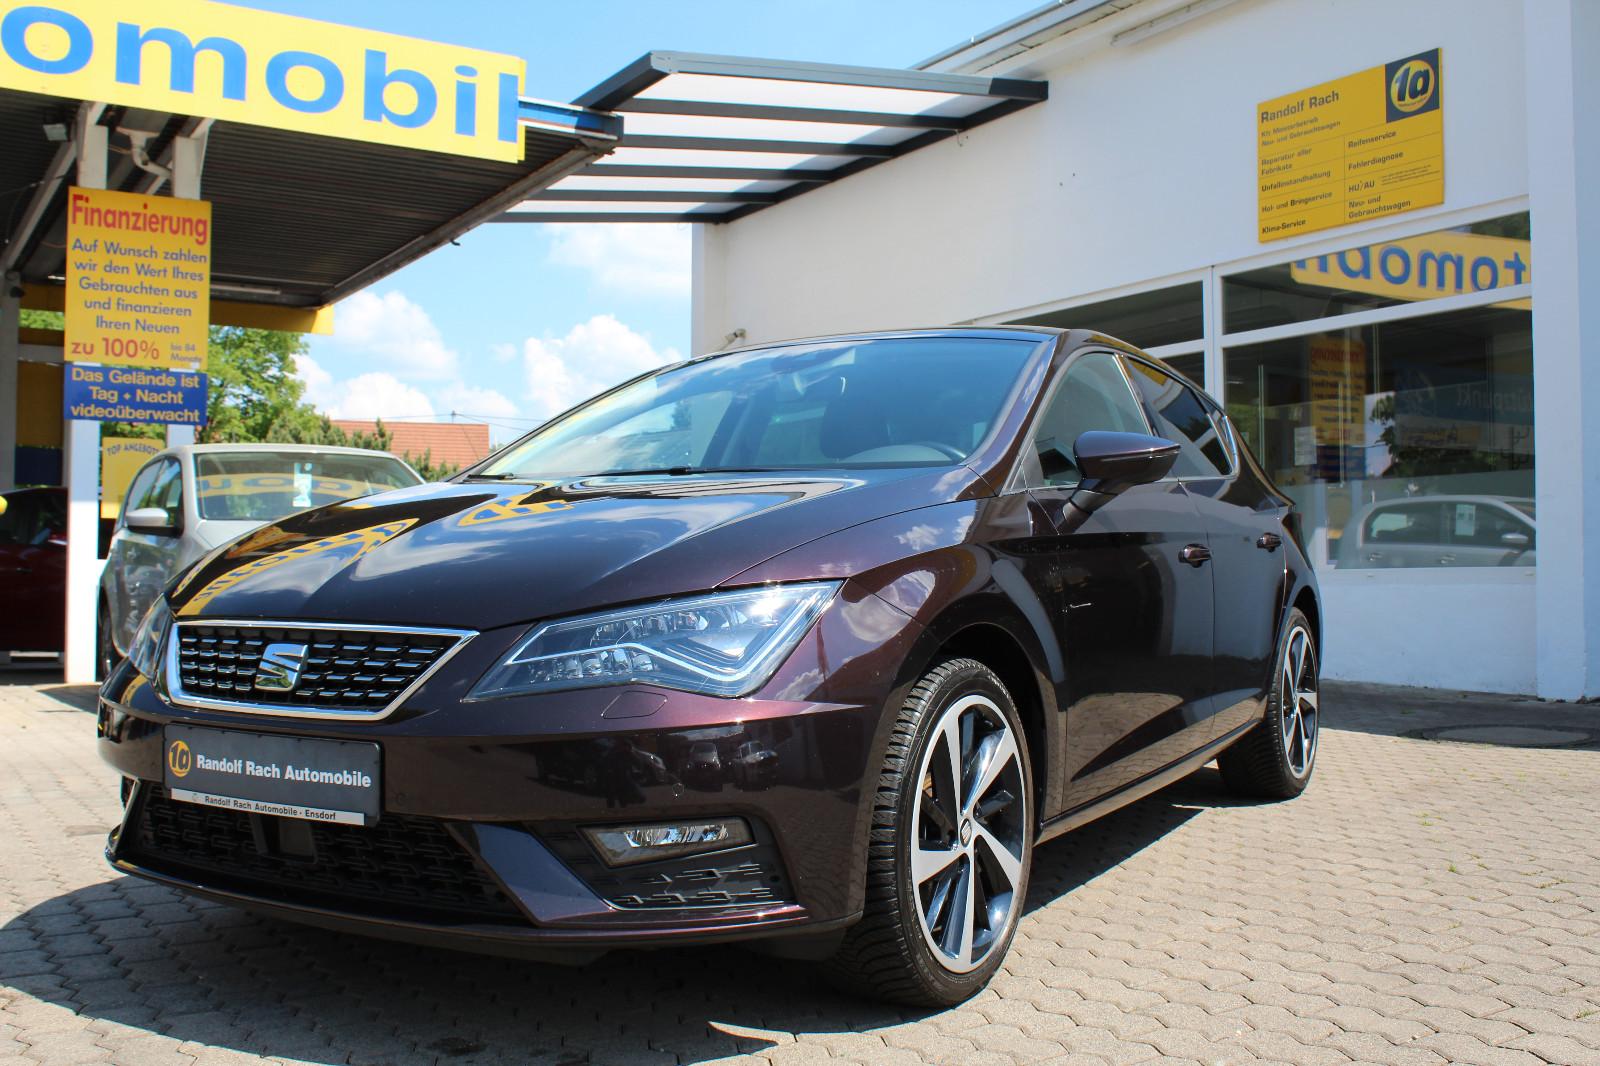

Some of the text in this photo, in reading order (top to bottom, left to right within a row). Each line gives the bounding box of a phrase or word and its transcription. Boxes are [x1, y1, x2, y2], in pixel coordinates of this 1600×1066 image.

[1396, 66, 1431, 102] 1a
[1261, 90, 1339, 123] Randolf Rach
[1289, 121, 1341, 139] Gebrauchtwagen
[1348, 131, 1397, 149] Reifenservice
[1262, 147, 1312, 166] Reparatur aller
[1348, 152, 1404, 171] Fehlerdiagnose
[1262, 163, 1293, 176] Fabrikate
[1276, 201, 1288, 210] und
[1290, 192, 1333, 207] Bringservice
[1348, 200, 1411, 219] Gebrauchtwagen
[1368, 195, 1381, 205] und
[72, 194, 208, 246] Finanzierung
[1262, 219, 1306, 235] Klima-Service
[72, 238, 207, 264] Auf Wunsch zahlen
[74, 259, 204, 282] wir den Wert Ihres
[79, 276, 198, 299] Gebrauchten aus
[84, 297, 192, 317] und finanzieren
[96, 315, 180, 334] Ihren Neuen
[71, 337, 160, 360] zu 100%
[72, 367, 200, 388] Das Gelände ist
[88, 386, 118, 403] Tag
[136, 389, 184, 404] Nacht
[70, 403, 200, 422] videoüberwacht
[107, 444, 121, 456] TOP
[196, 754, 372, 788] Randolf Rach Automobile
[204, 796, 231, 807] Randolf
[233, 799, 252, 810] Rach
[254, 803, 297, 816] Automobile
[305, 809, 336, 821] Ensdorf
